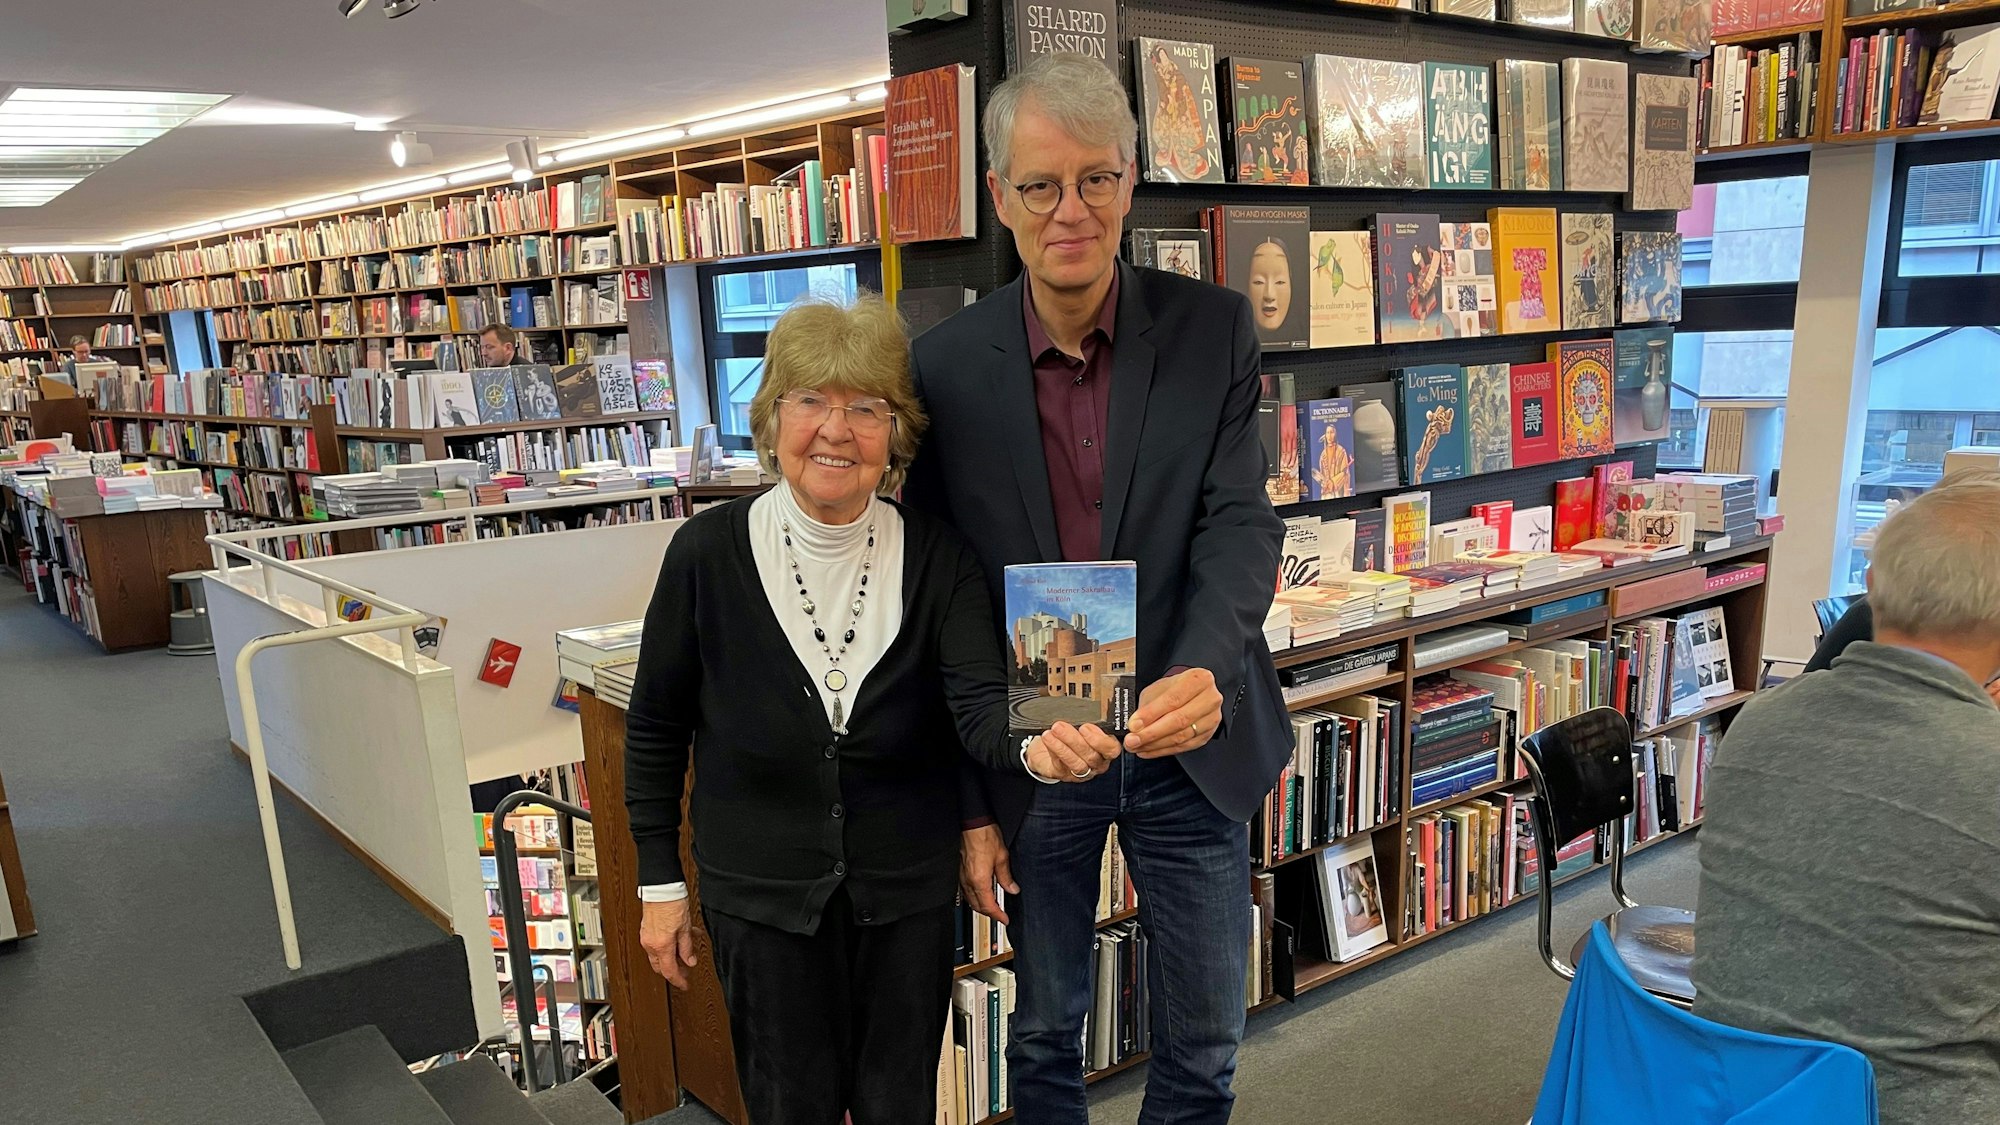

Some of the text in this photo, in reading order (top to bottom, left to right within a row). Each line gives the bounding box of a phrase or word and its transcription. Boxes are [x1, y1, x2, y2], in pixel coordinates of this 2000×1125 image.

[1027, 5, 1107, 34] SHARED
[1029, 31, 1106, 59] PASSION
[1174, 46, 1198, 58] MADE
[1189, 59, 1199, 69] IN
[1777, 46, 1790, 111] DREAMING THE LAND
[1723, 74, 1735, 117] MADAYIN
[1200, 49, 1220, 168] JAPAN
[892, 117, 936, 134] Erzählte Welt
[1651, 117, 1683, 130] KARTEN
[1230, 210, 1308, 219] NOH AND KYOGEN MASKS
[1503, 215, 1555, 231] KIMONO
[1325, 302, 1345, 310] culture
[1350, 300, 1368, 311] Japan
[1408, 373, 1428, 389] L'or
[1513, 372, 1552, 387] CHINESE
[1416, 386, 1458, 404] des Ming
[1513, 383, 1552, 393] CHARACTERS
[1523, 403, 1543, 432] 壽
[1404, 549, 1427, 561] MUSEUM
[1081, 585, 1116, 594] Sakralbau
[1344, 661, 1354, 671] DIE
[1354, 654, 1376, 668] GÄRTEN
[1375, 649, 1398, 663] JAPANS
[1285, 781, 1293, 830] Silk Roads
